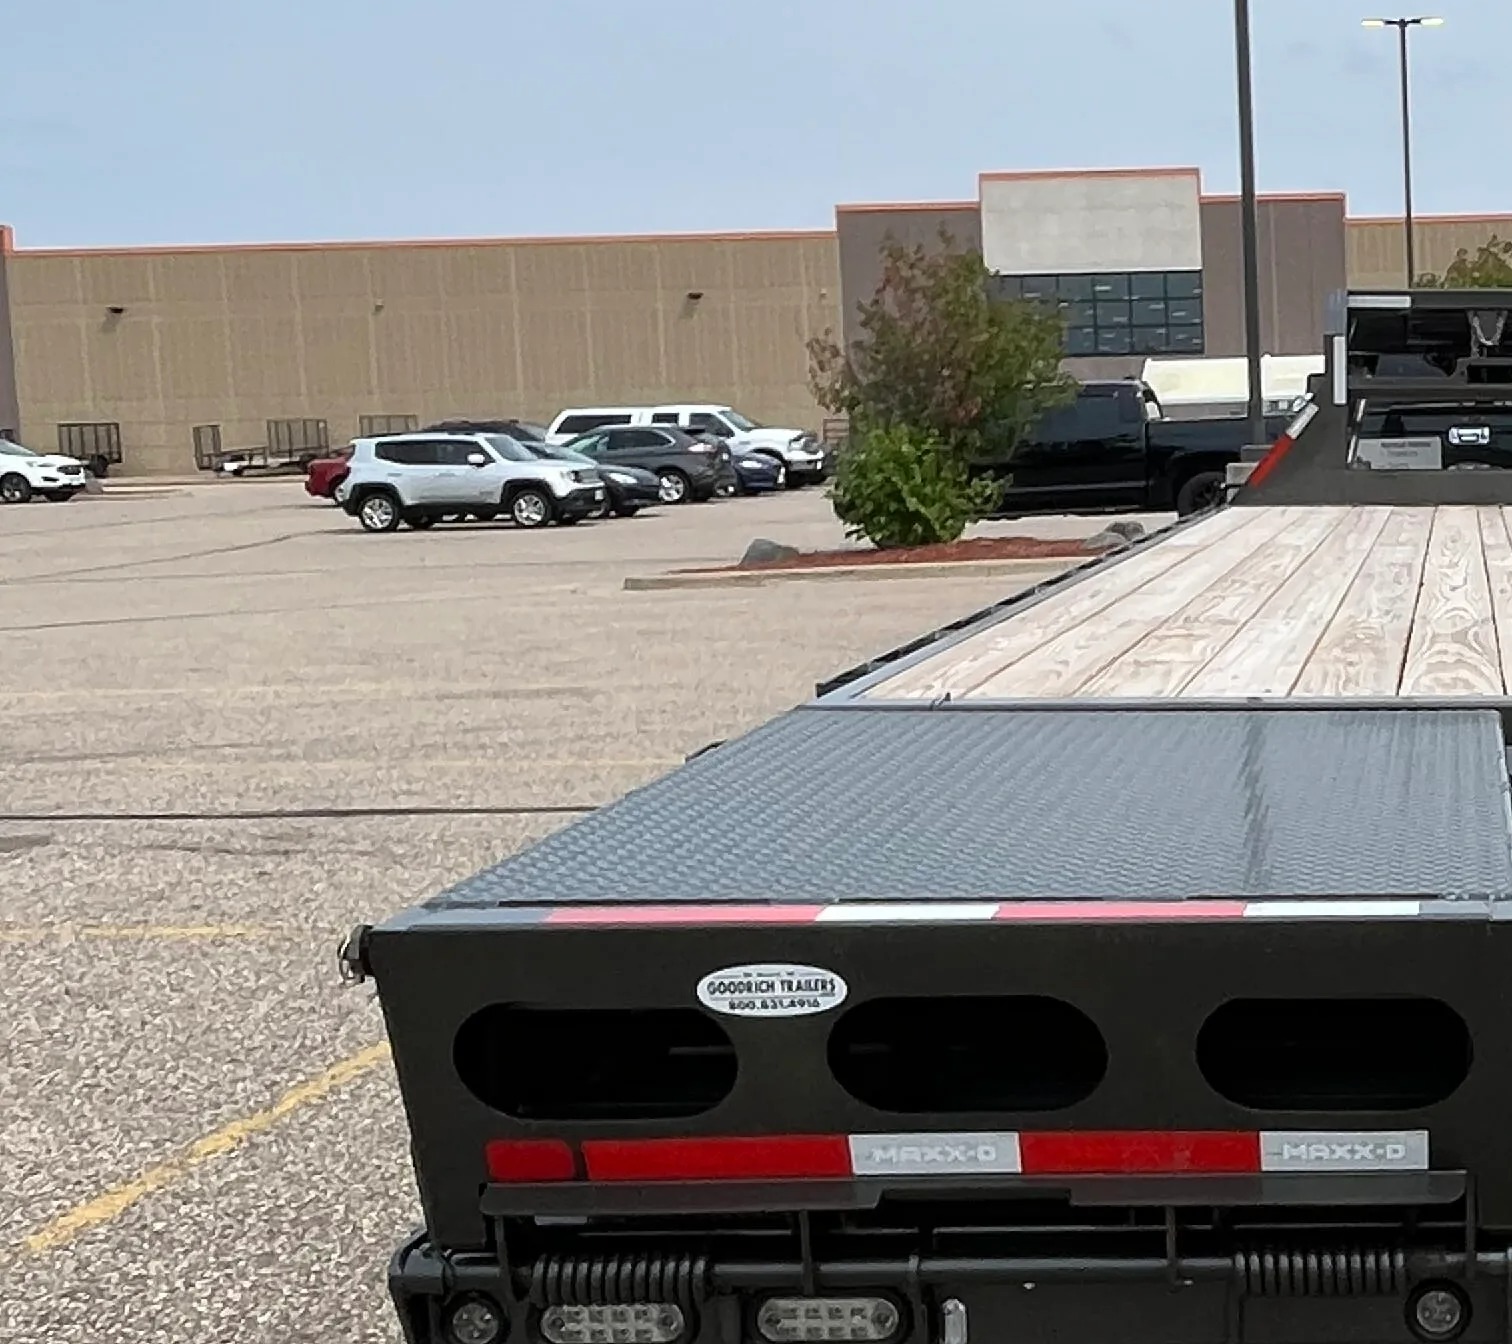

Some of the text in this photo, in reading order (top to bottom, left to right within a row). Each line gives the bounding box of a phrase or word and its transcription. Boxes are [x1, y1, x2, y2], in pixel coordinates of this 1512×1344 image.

[706, 976, 836, 995] GOODRICH TRAILERS
[1282, 1143, 1406, 1160] MAXX-D
